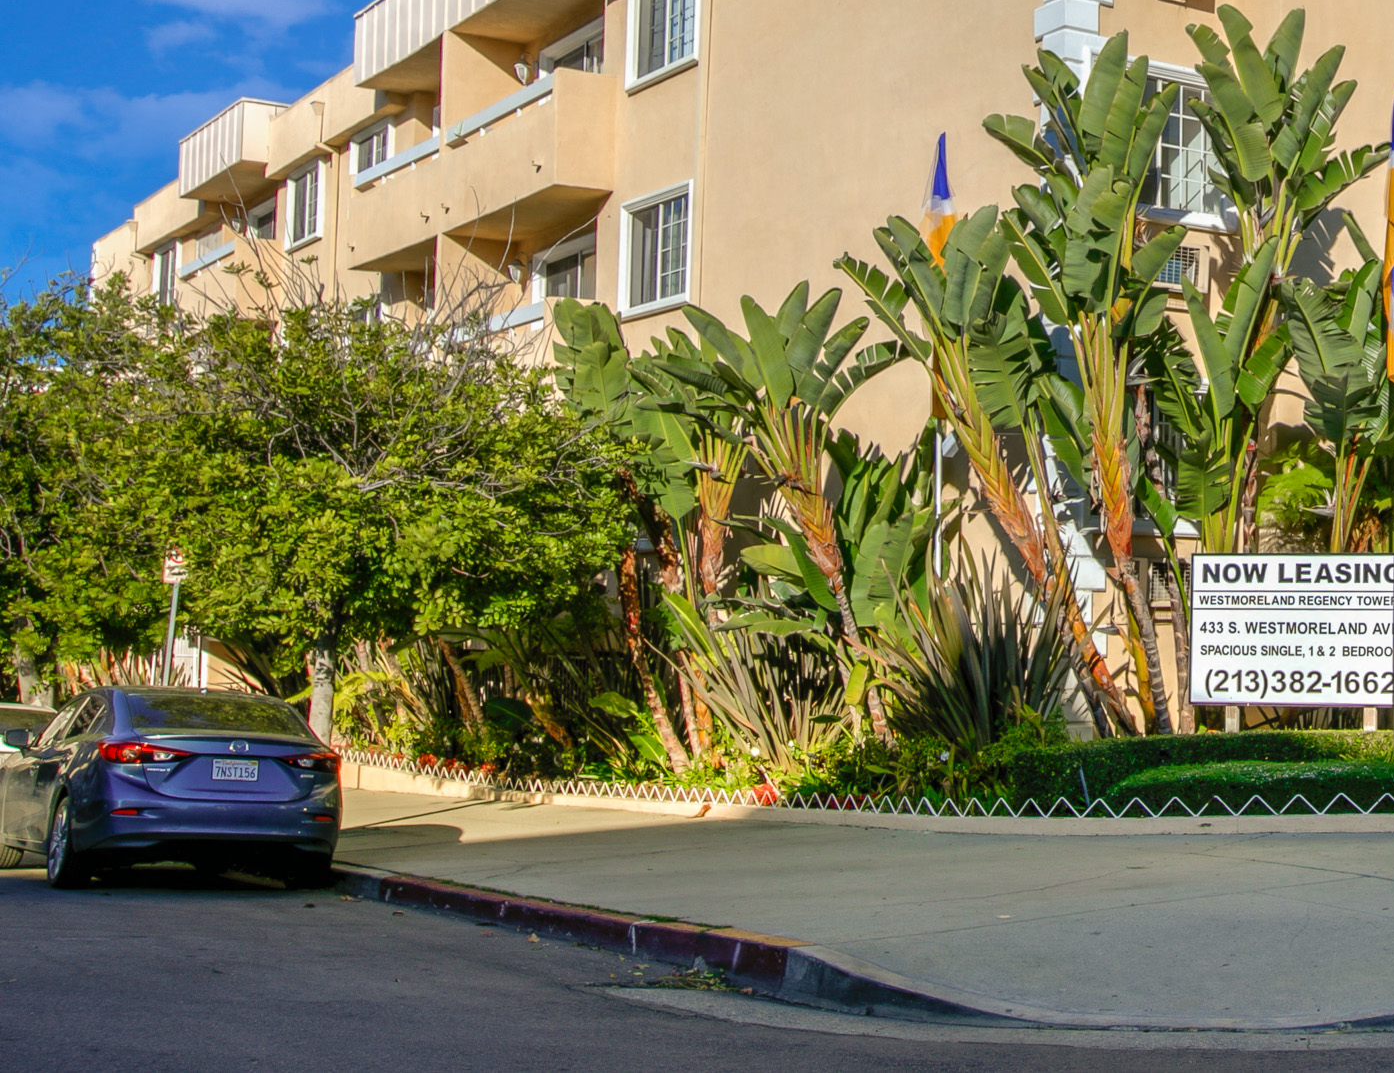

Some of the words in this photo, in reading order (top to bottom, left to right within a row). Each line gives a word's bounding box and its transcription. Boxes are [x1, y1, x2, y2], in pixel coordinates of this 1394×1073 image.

[1202, 563, 1268, 584] NOW
[1199, 595, 1296, 606] WESTMORELAND
[1298, 595, 1353, 606] REGENCY
[1199, 621, 1224, 634] 433
[1228, 621, 1240, 634] S.
[1244, 621, 1368, 635] WESTMORELAND
[1200, 645, 1257, 656] SPACIOUS
[1260, 645, 1305, 658] SINGLE,
[1316, 646, 1325, 657] &
[1329, 646, 1336, 657] 2
[1204, 669, 1394, 699] (213)382-1662
[215, 766, 256, 778] 7NST156
